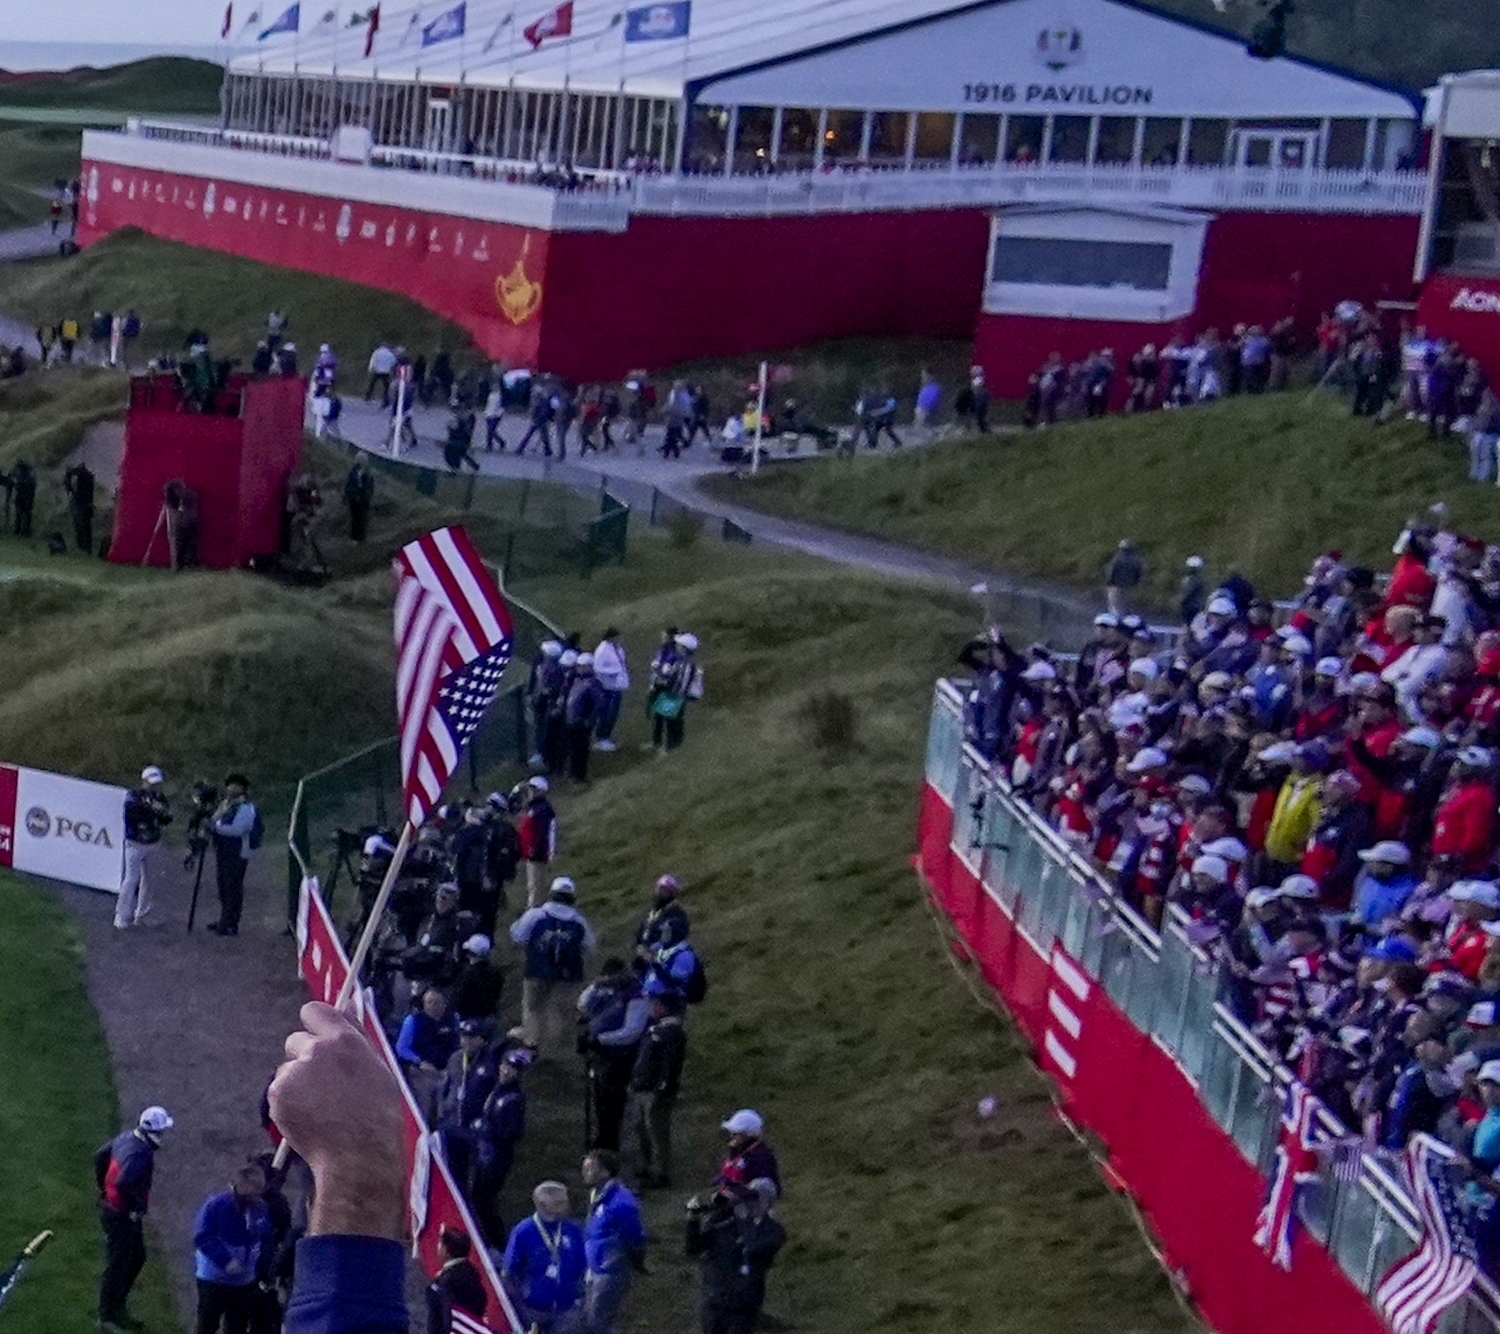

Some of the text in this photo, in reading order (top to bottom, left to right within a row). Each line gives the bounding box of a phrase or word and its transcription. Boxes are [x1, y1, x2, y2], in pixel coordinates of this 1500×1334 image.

[962, 81, 1153, 105] 1916 PAVILION
[54, 816, 114, 850] PGA
